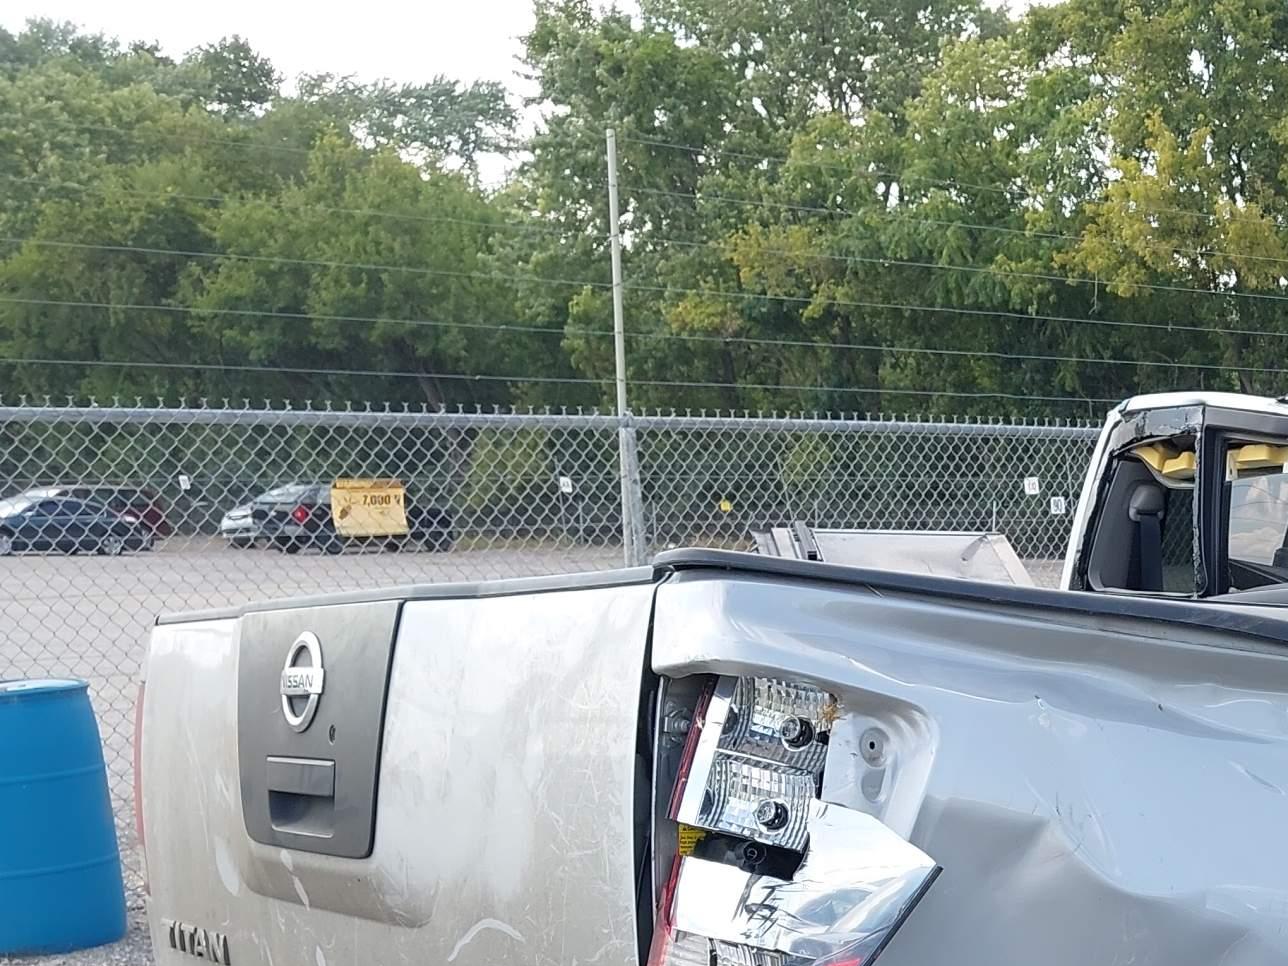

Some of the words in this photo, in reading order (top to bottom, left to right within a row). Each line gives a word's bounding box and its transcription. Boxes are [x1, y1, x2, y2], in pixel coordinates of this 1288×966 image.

[362, 494, 391, 507] 7,000
[281, 674, 314, 689] NISSAN
[160, 917, 231, 966] TITAN
